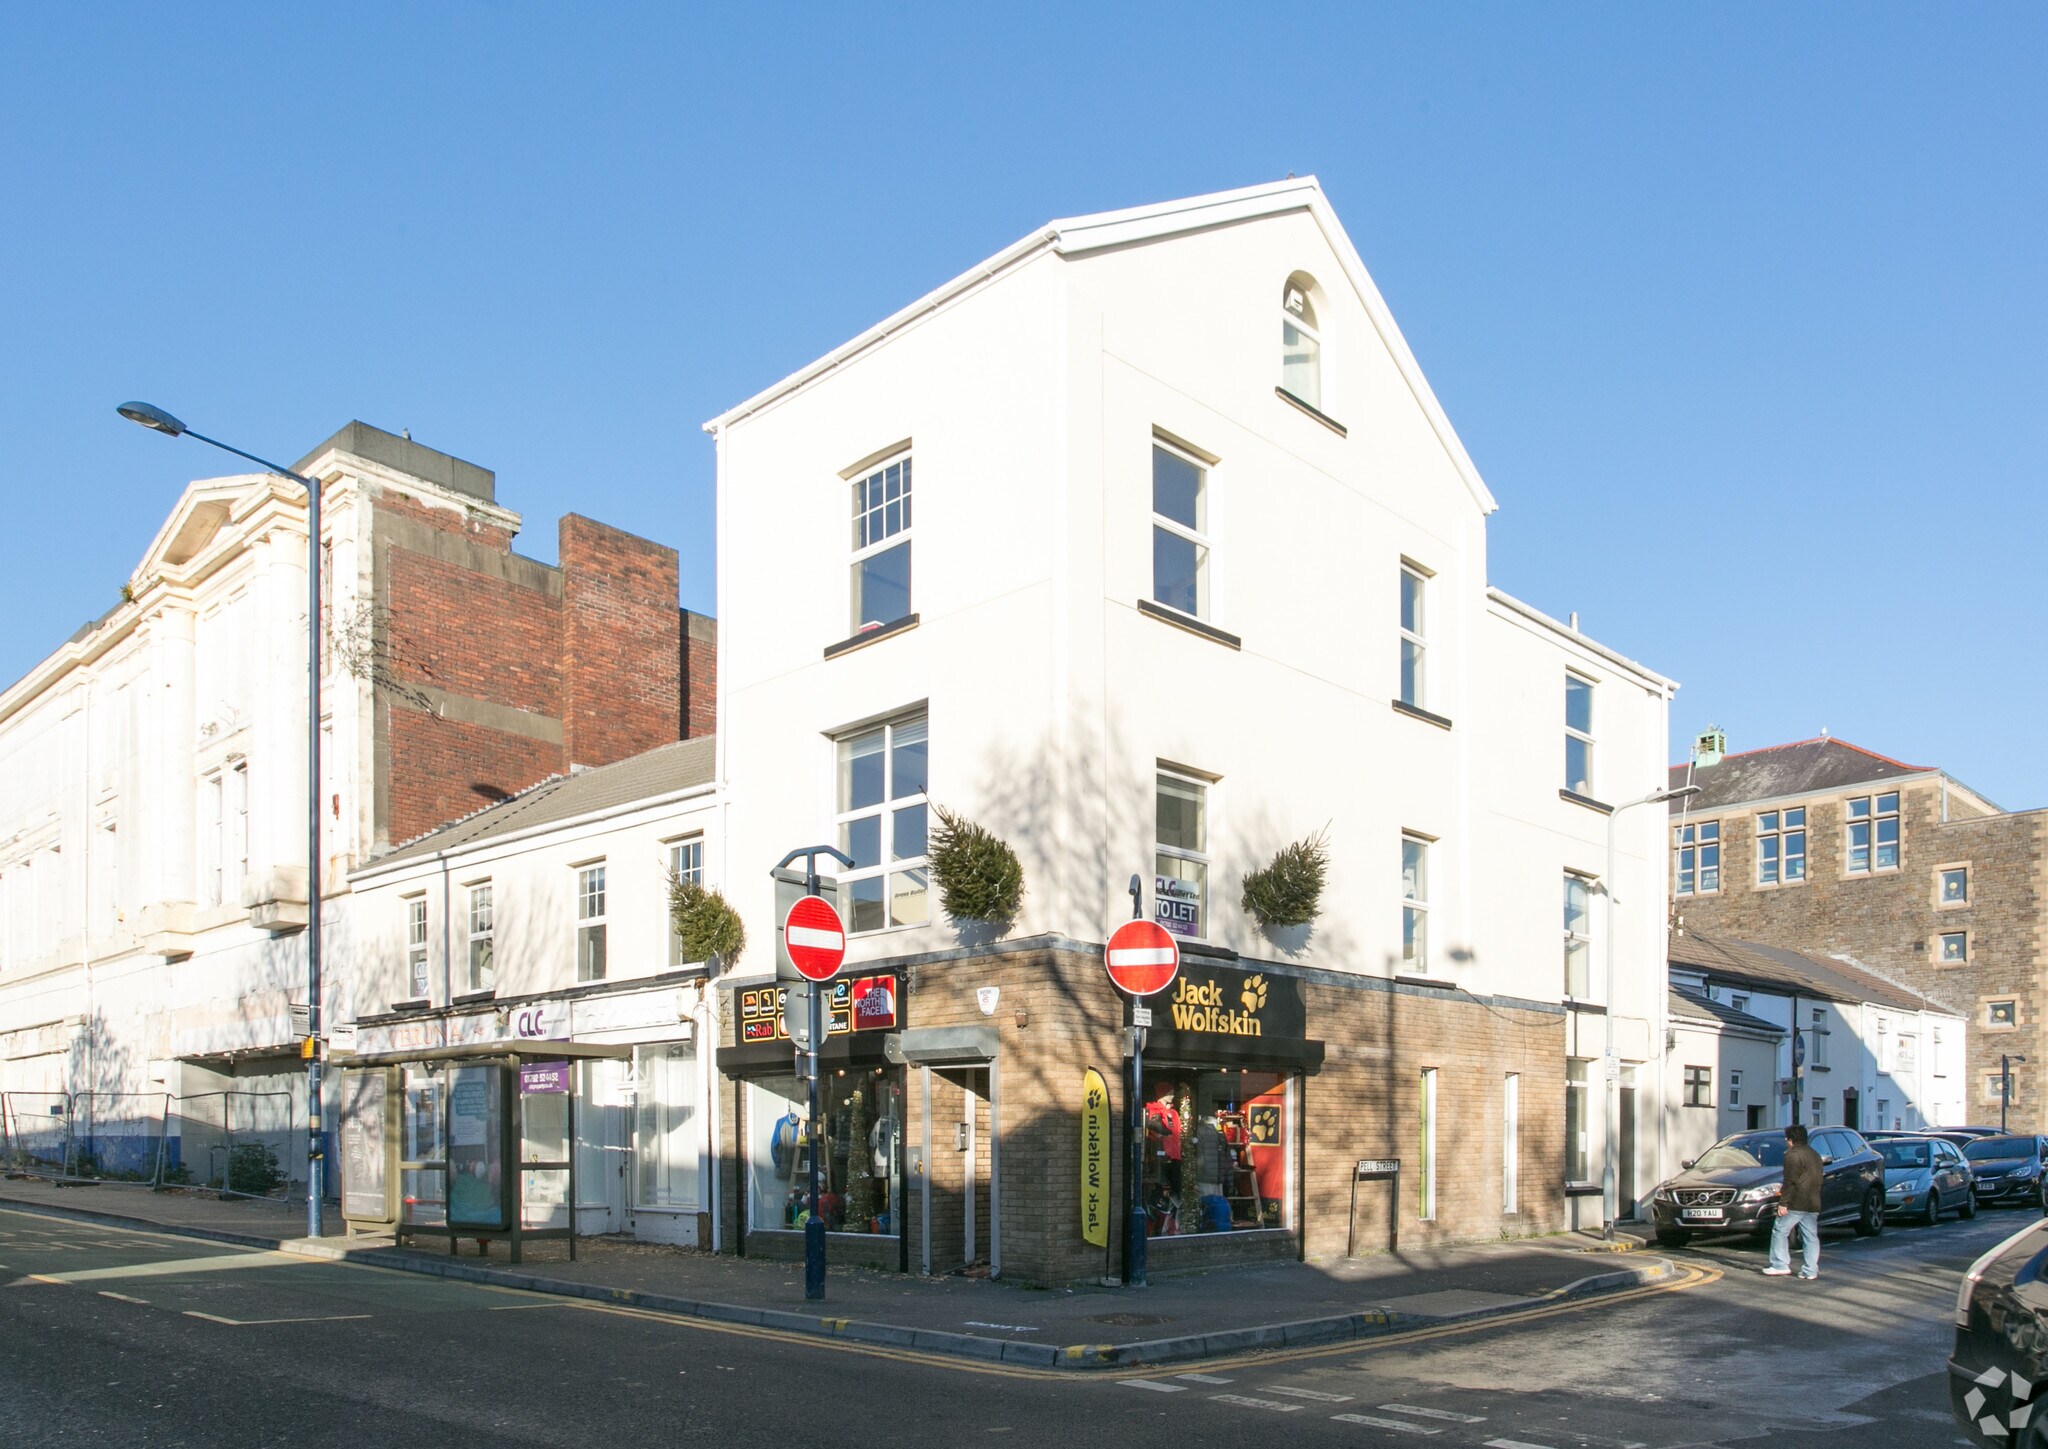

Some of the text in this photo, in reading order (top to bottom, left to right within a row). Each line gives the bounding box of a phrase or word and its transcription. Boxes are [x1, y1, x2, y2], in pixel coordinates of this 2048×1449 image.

[1156, 900, 1195, 922] TO LET
[865, 988, 880, 998] THE
[1172, 977, 1223, 1006] Jack
[855, 997, 880, 1009] NORTH
[861, 1005, 880, 1016] FACE
[1172, 1003, 1261, 1036] Wolfskin
[388, 1022, 465, 1048] VERONA
[755, 1023, 773, 1037] Rab
[1361, 1161, 1396, 1170] PELL STREET
